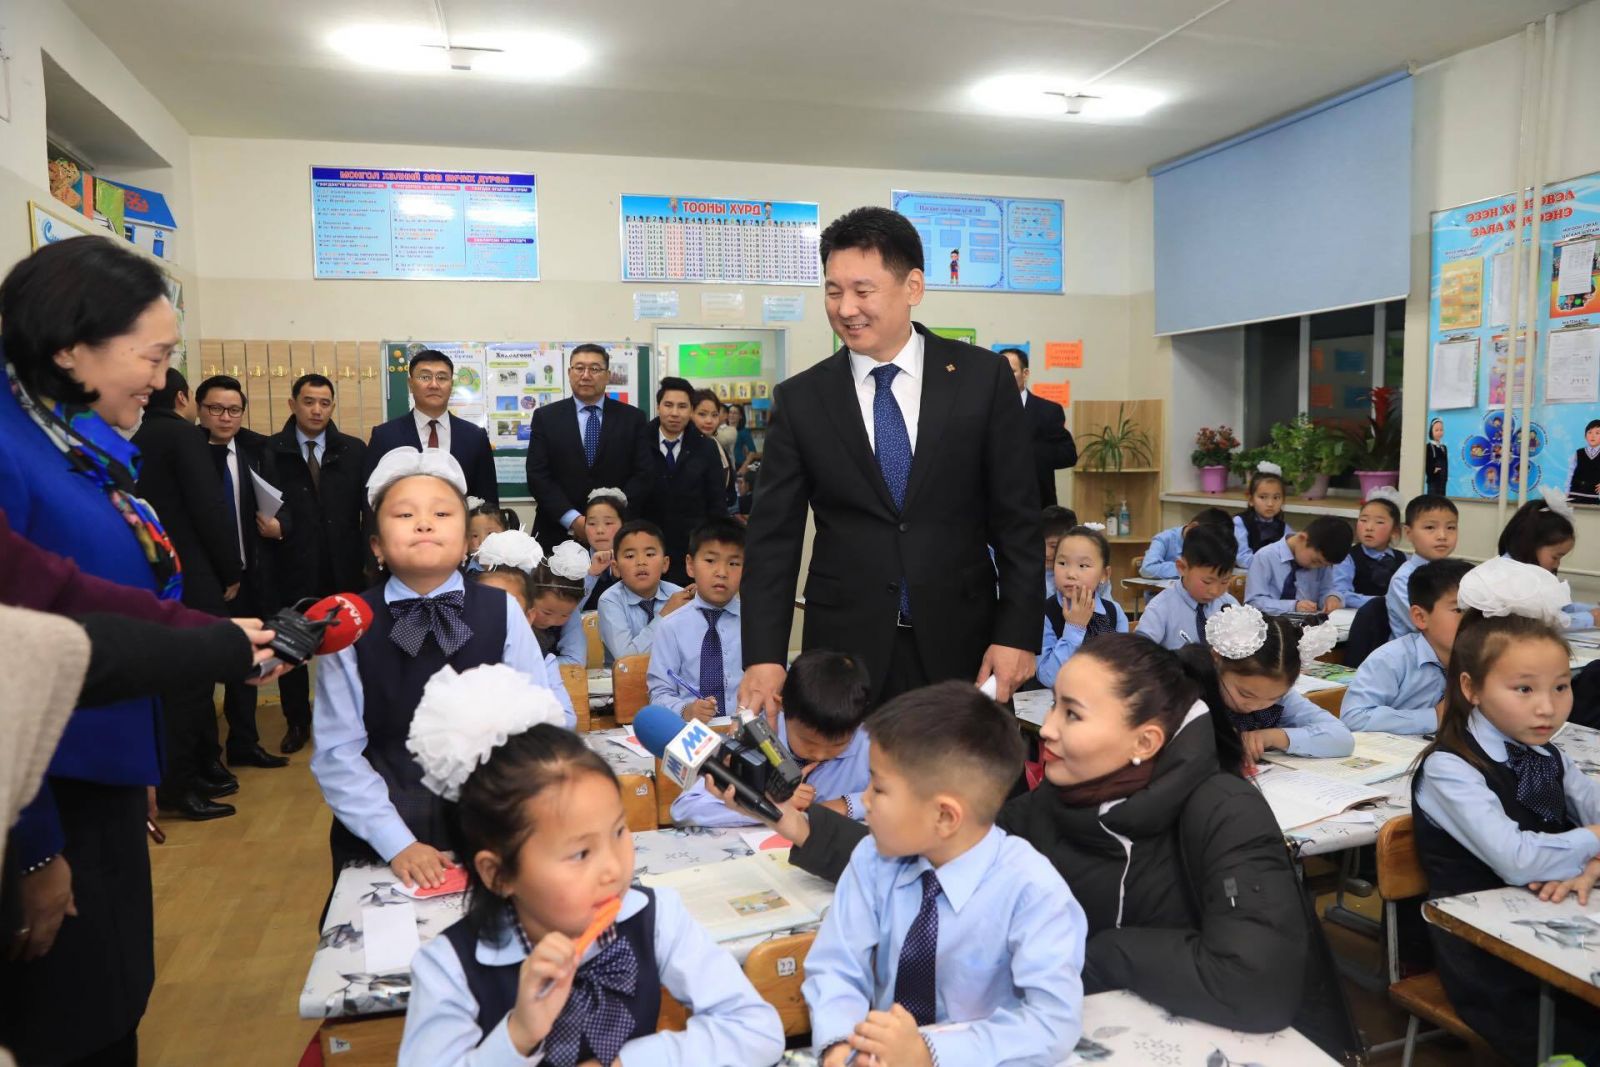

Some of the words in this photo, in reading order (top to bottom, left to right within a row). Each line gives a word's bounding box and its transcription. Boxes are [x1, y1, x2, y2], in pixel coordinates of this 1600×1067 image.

[340, 170, 379, 180] МОНГОЛ
[382, 171, 420, 181] ХЭЛНИЙ
[423, 173, 443, 182] ЗӨВ
[478, 175, 510, 184] ДҮРЭМ
[682, 201, 726, 214] ТООНЫ
[729, 203, 761, 216] ХҮРД
[1466, 208, 1499, 223] ЭЗЭН
[1471, 223, 1505, 238] ЗАЯА
[1507, 207, 1574, 229] ХЧЭНЭ
